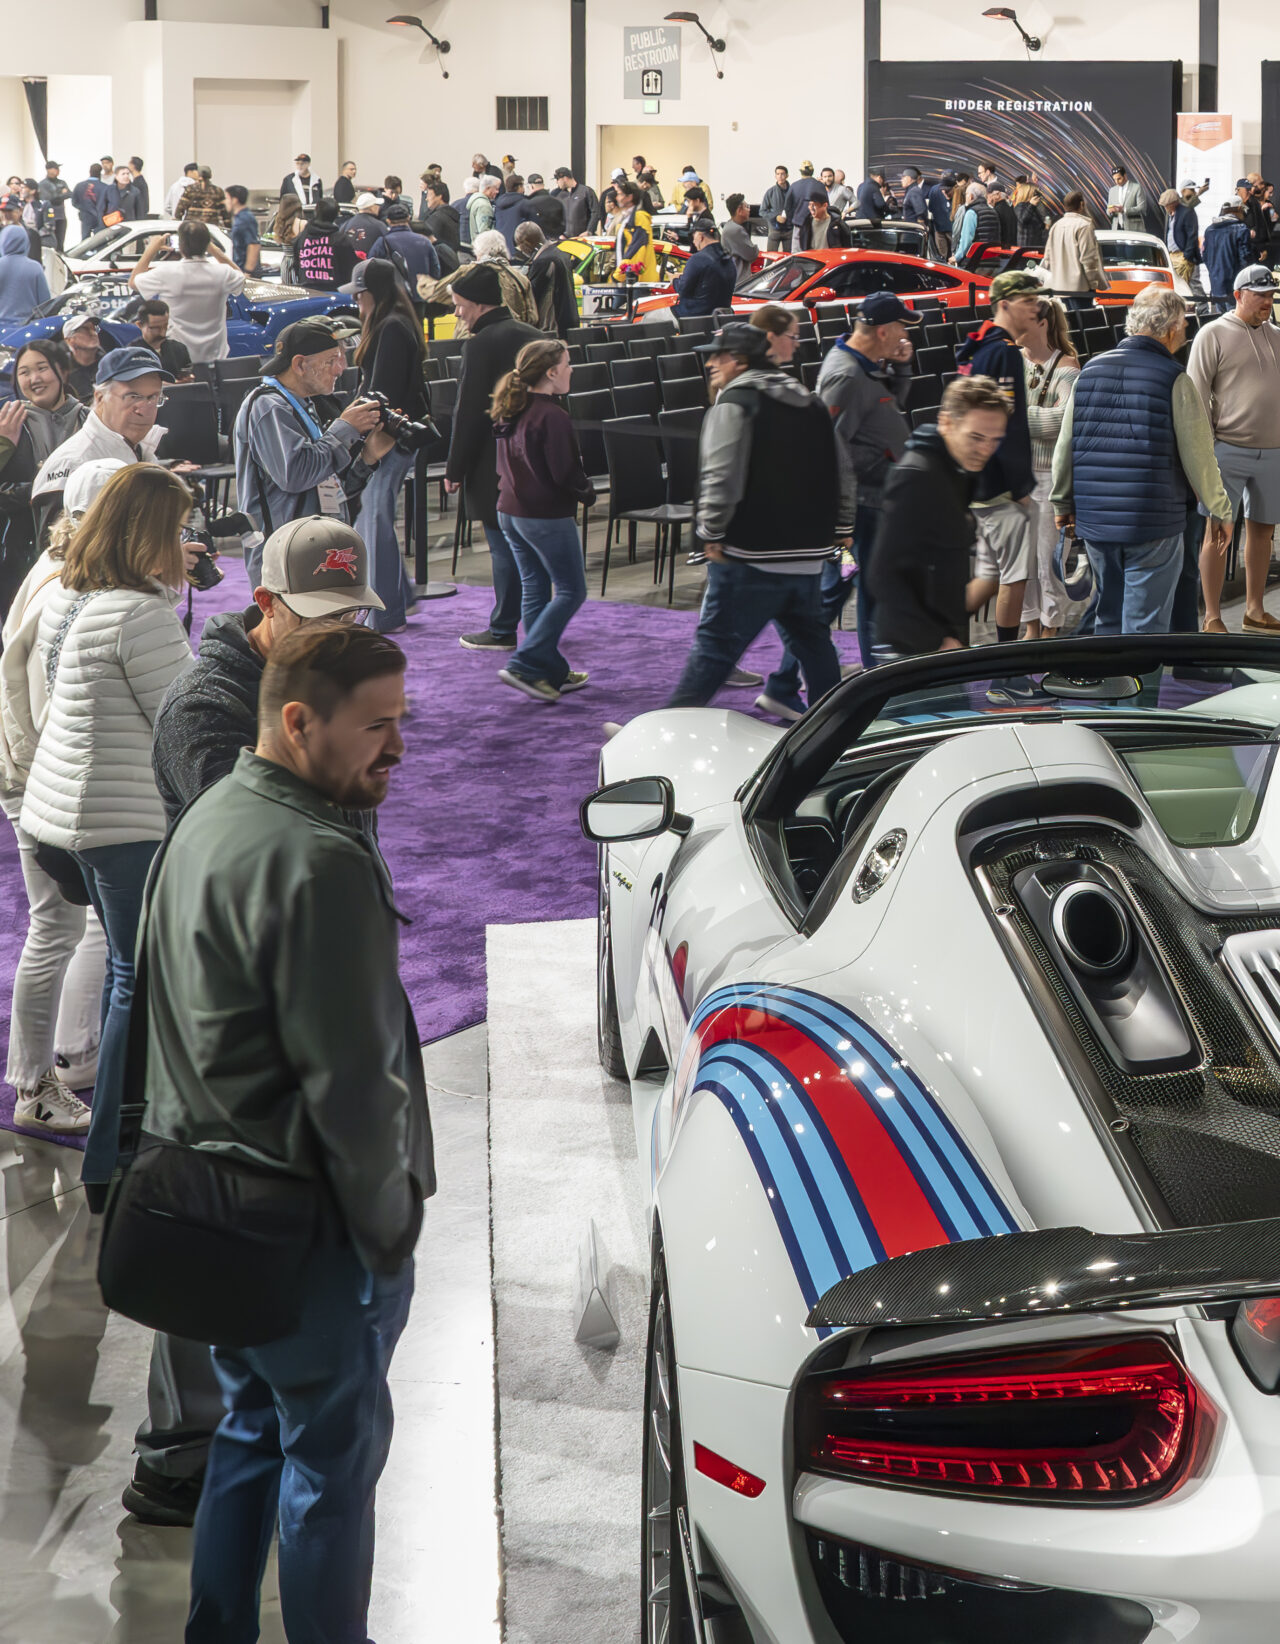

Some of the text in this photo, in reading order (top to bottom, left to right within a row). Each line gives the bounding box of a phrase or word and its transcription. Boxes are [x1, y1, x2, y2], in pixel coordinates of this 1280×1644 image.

[630, 28, 666, 51] PUBLIC
[624, 44, 679, 72] RESTROOM
[945, 100, 1093, 112] BIDDER REGISTRATION
[304, 236, 329, 247] ANTI
[299, 246, 334, 258] SOCIAL
[300, 258, 334, 269] SOCIAL
